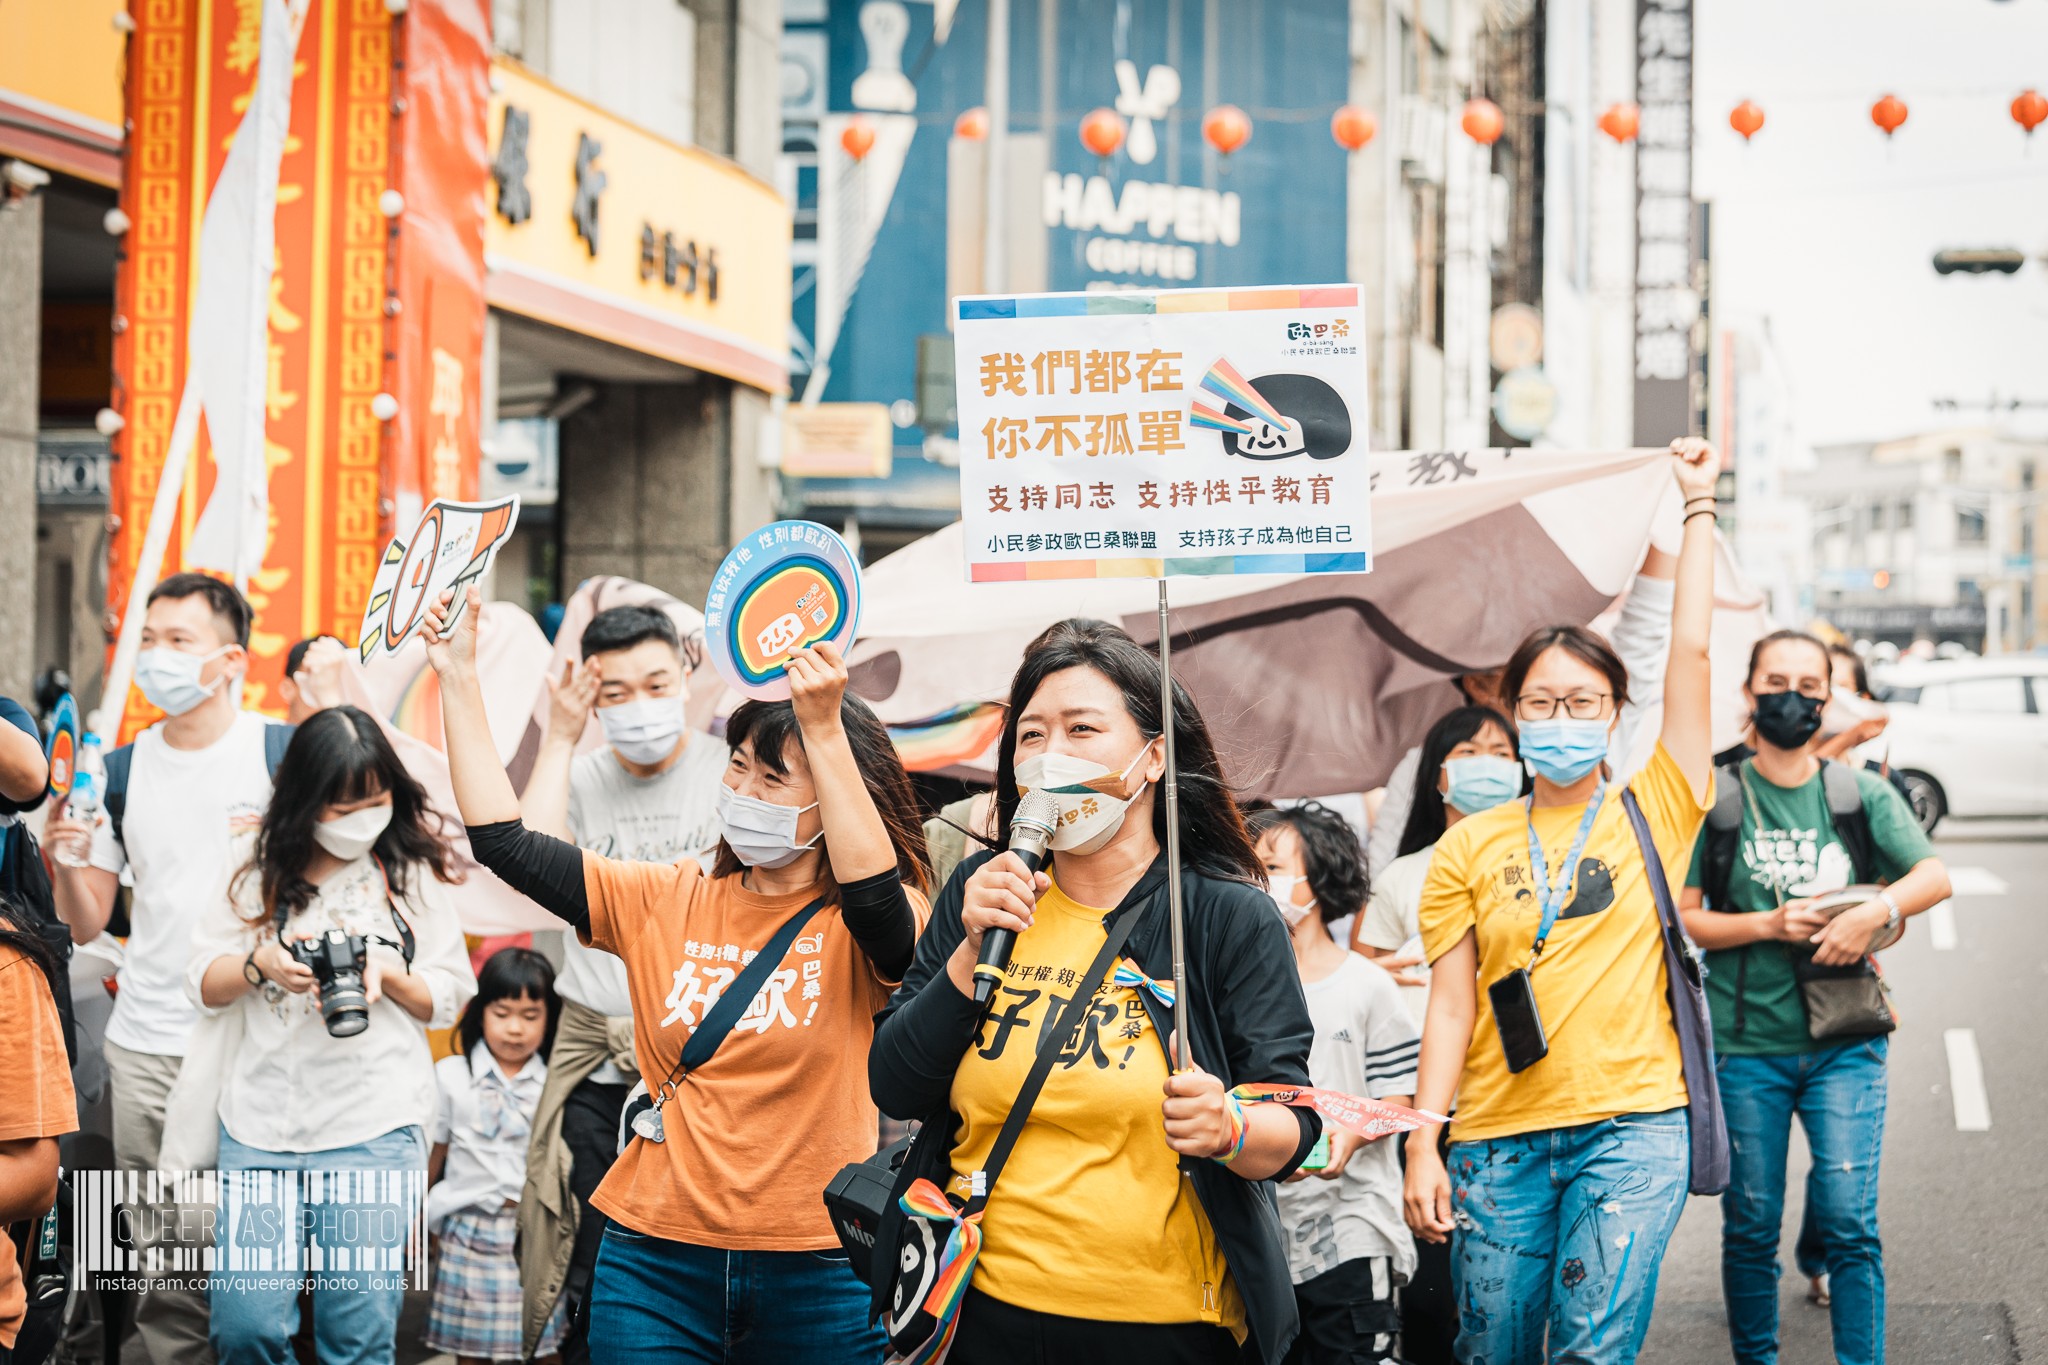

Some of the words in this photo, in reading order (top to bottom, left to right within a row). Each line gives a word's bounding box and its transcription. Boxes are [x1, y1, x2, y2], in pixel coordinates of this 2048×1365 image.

[1287, 319, 1350, 341] 歐巴桑
[979, 348, 1184, 398] 我們都在
[981, 409, 1186, 460] 你不孤單
[987, 481, 1117, 513] 支持同志
[1137, 473, 1334, 510] 支持性平教育
[987, 530, 1158, 553] 小民參政歐巴桑聯盟
[1178, 525, 1353, 548] 支持孩子成為他自己
